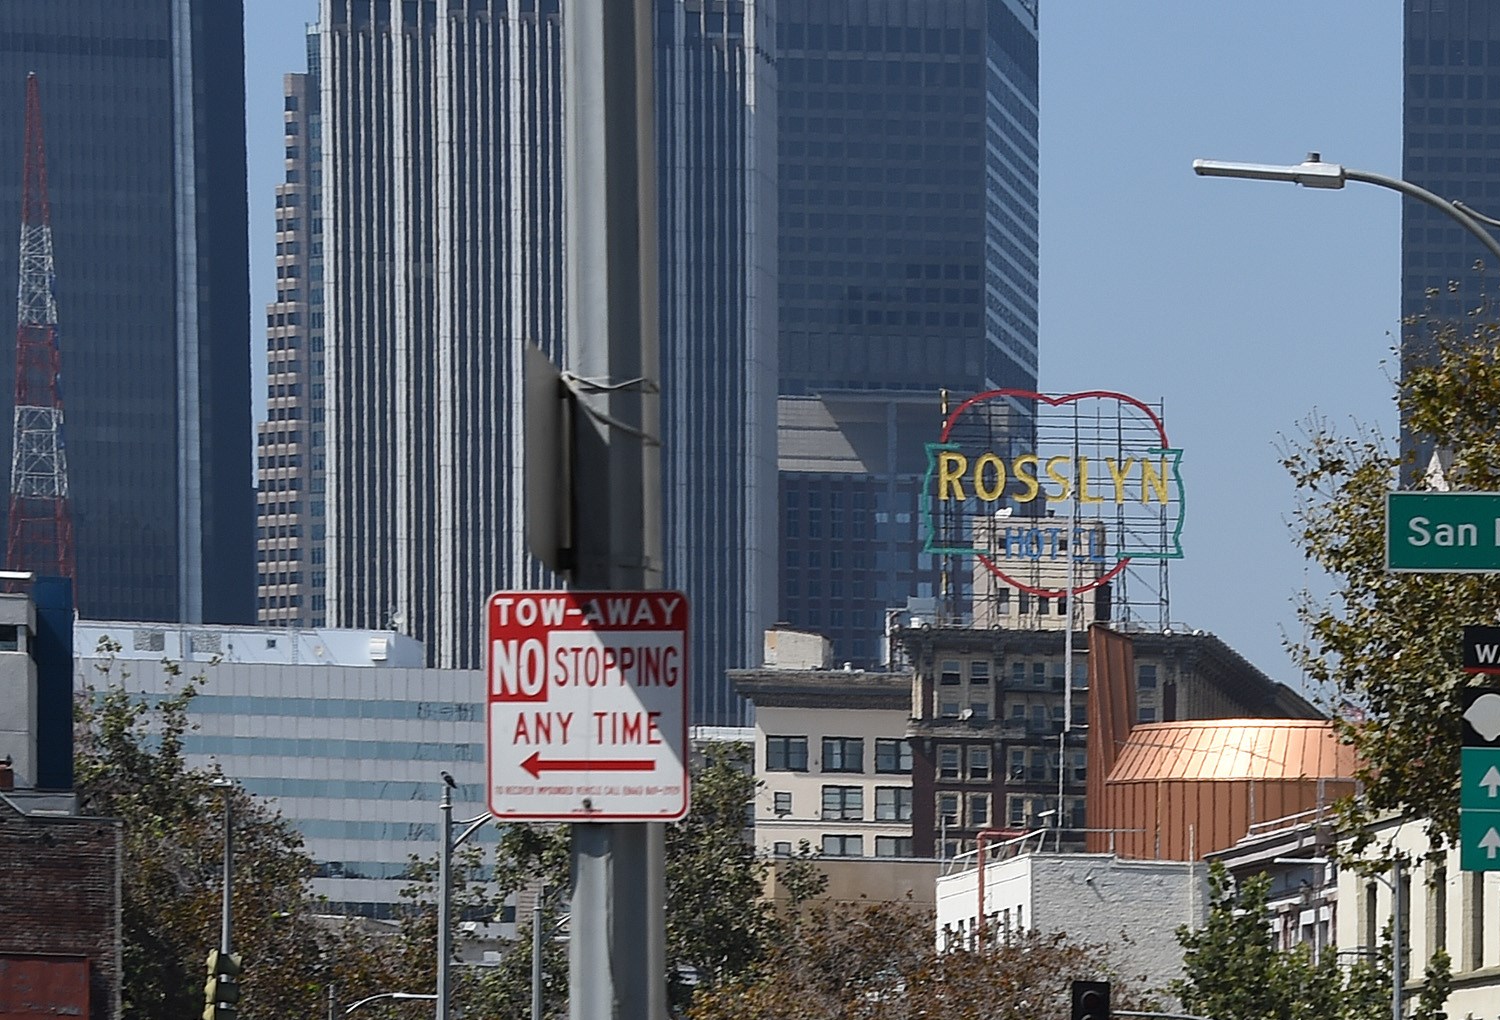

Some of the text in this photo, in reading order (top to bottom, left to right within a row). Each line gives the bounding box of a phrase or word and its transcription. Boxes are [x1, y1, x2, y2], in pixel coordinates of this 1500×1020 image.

[939, 452, 1168, 504] ROSSLYN
[1407, 516, 1477, 546] San
[494, 598, 680, 626] TOW-AWAY
[493, 639, 679, 696] NO STOPPING
[513, 712, 662, 745] ANY TIME
